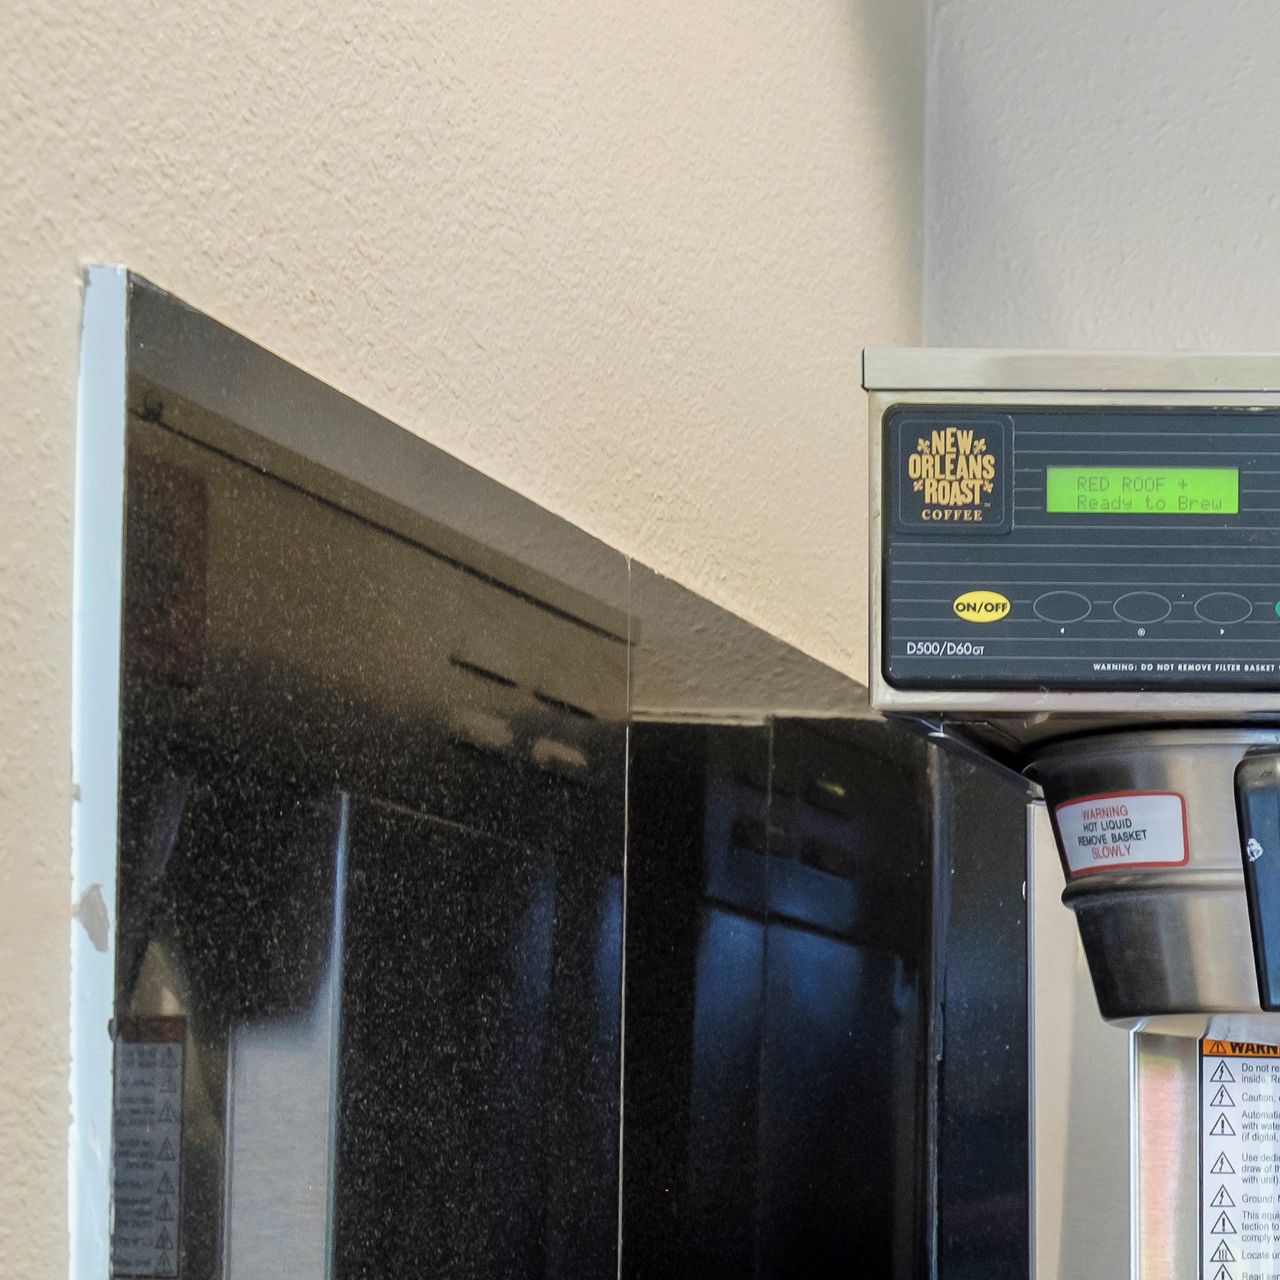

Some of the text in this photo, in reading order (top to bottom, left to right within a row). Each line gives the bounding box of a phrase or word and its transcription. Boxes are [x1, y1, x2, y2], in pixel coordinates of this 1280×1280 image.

[932, 427, 973, 455] NEW
[909, 453, 995, 480] ORLEANS
[1077, 477, 1188, 492] RED ROOF +
[924, 479, 983, 506] ROAST
[1077, 495, 1222, 510] Ready to Brew
[922, 509, 982, 521] COFFEE
[955, 602, 1008, 613] ON/OFF
[906, 641, 985, 656] D500/D60GT
[1093, 663, 1137, 671] WARNING:
[1244, 664, 1275, 672] BASKET
[1081, 804, 1128, 821] WARNING
[1083, 818, 1132, 832] HOT LIQUID
[1078, 829, 1147, 846] REMOVE BASKET
[1092, 844, 1131, 860] SLOWLY
[1242, 1063, 1253, 1072] Do
[1256, 1064, 1269, 1072] not
[1242, 1153, 1258, 1162] Use
[1242, 1164, 1261, 1173] draw
[1242, 1176, 1258, 1184] with
[1242, 1210, 1259, 1219] This
[1242, 1222, 1269, 1231] tection
[1272, 1222, 1279, 1231] to
[1242, 1233, 1270, 1243] comply
[1242, 1251, 1269, 1260] Locate
[1242, 1272, 1264, 1280] Read
